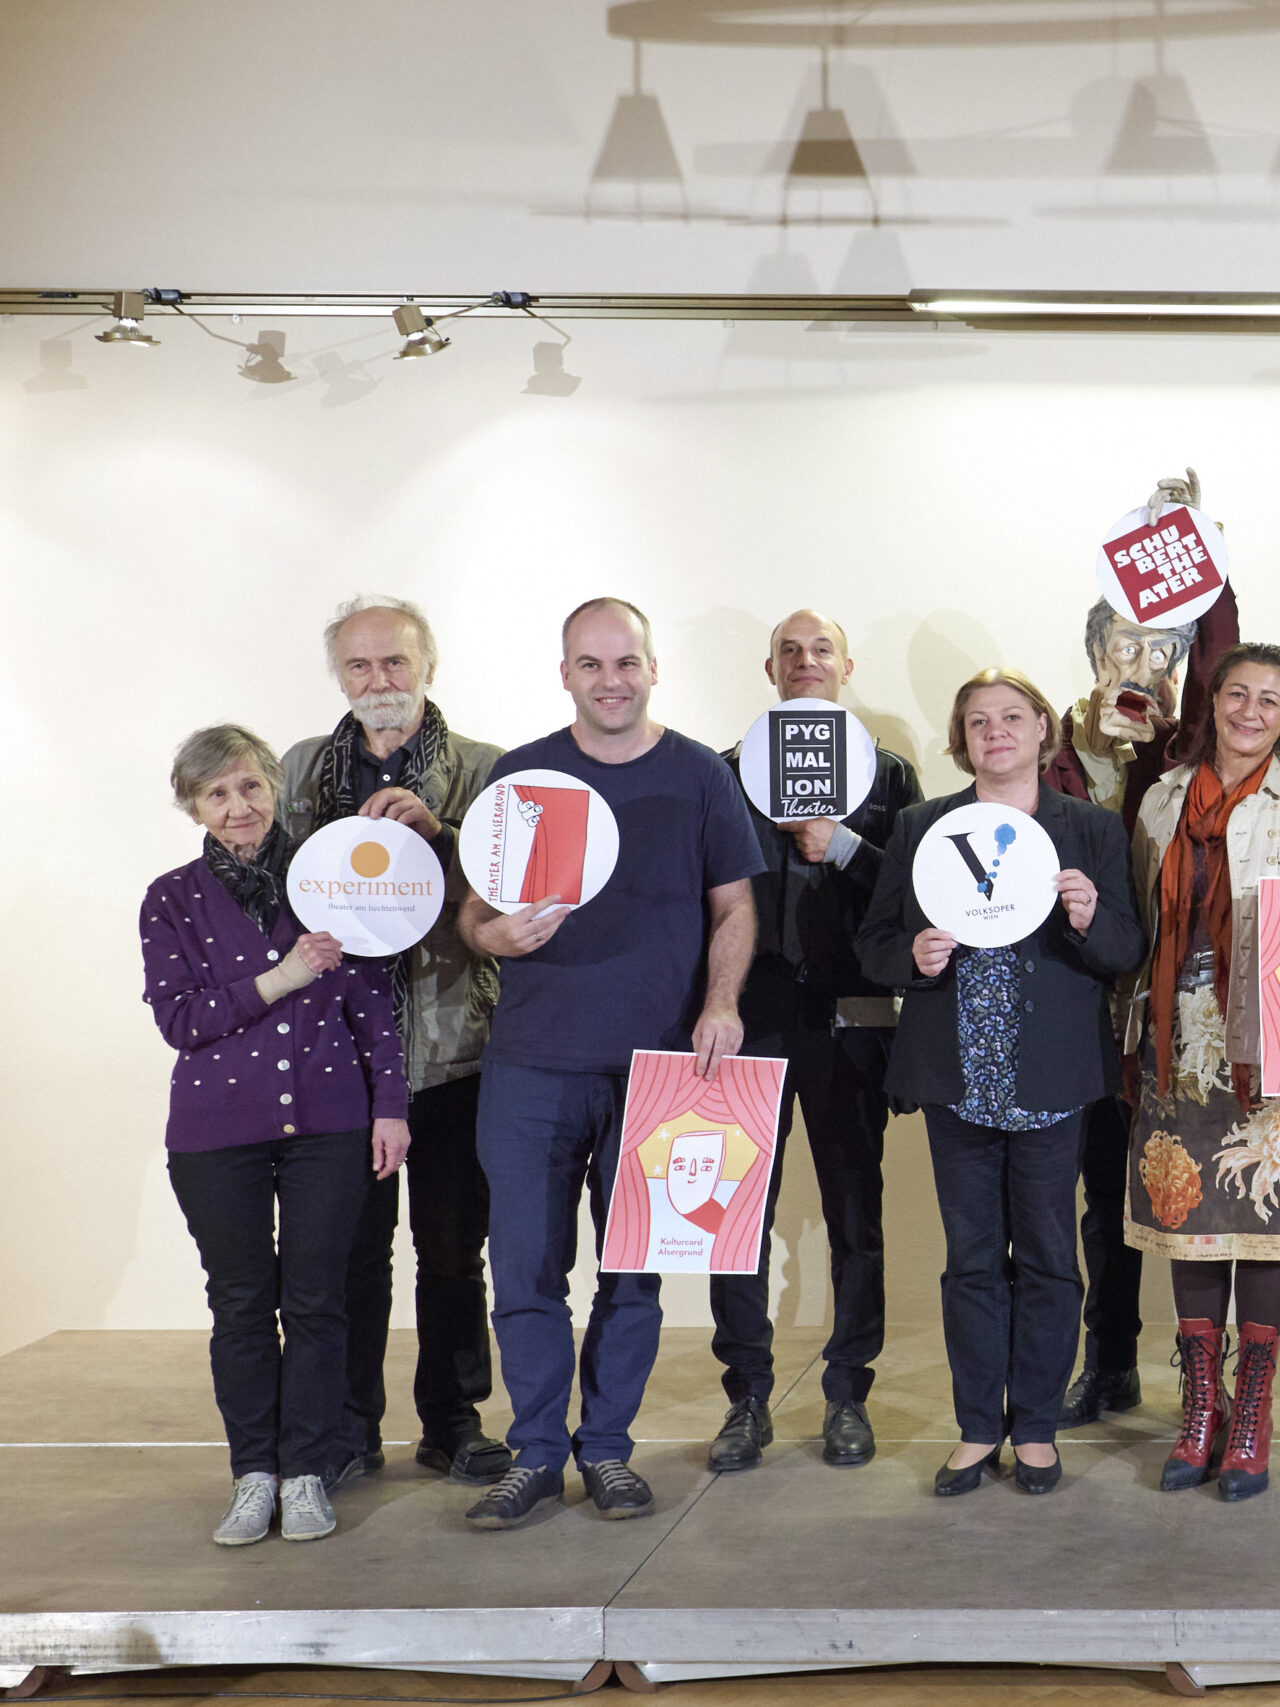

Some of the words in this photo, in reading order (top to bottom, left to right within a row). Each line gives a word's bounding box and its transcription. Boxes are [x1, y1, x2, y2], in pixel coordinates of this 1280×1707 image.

[1113, 525, 1180, 569] SCHU
[1135, 532, 1197, 575] BERT
[1156, 545, 1208, 580] THE
[1138, 567, 1204, 610] ATER
[785, 724, 831, 741] PYG
[785, 751, 831, 768] MAL
[786, 779, 831, 796] ION
[492, 783, 506, 840] ALSERGRUND
[781, 798, 837, 817] Theater
[491, 843, 503, 858] AM
[299, 879, 433, 899] experiment
[488, 860, 501, 902] THEATER
[328, 903, 353, 911] theater
[965, 904, 1016, 917] VOLKSOPER
[660, 1237, 703, 1247] Kulturcard
[657, 1247, 704, 1257] Alsergrund
